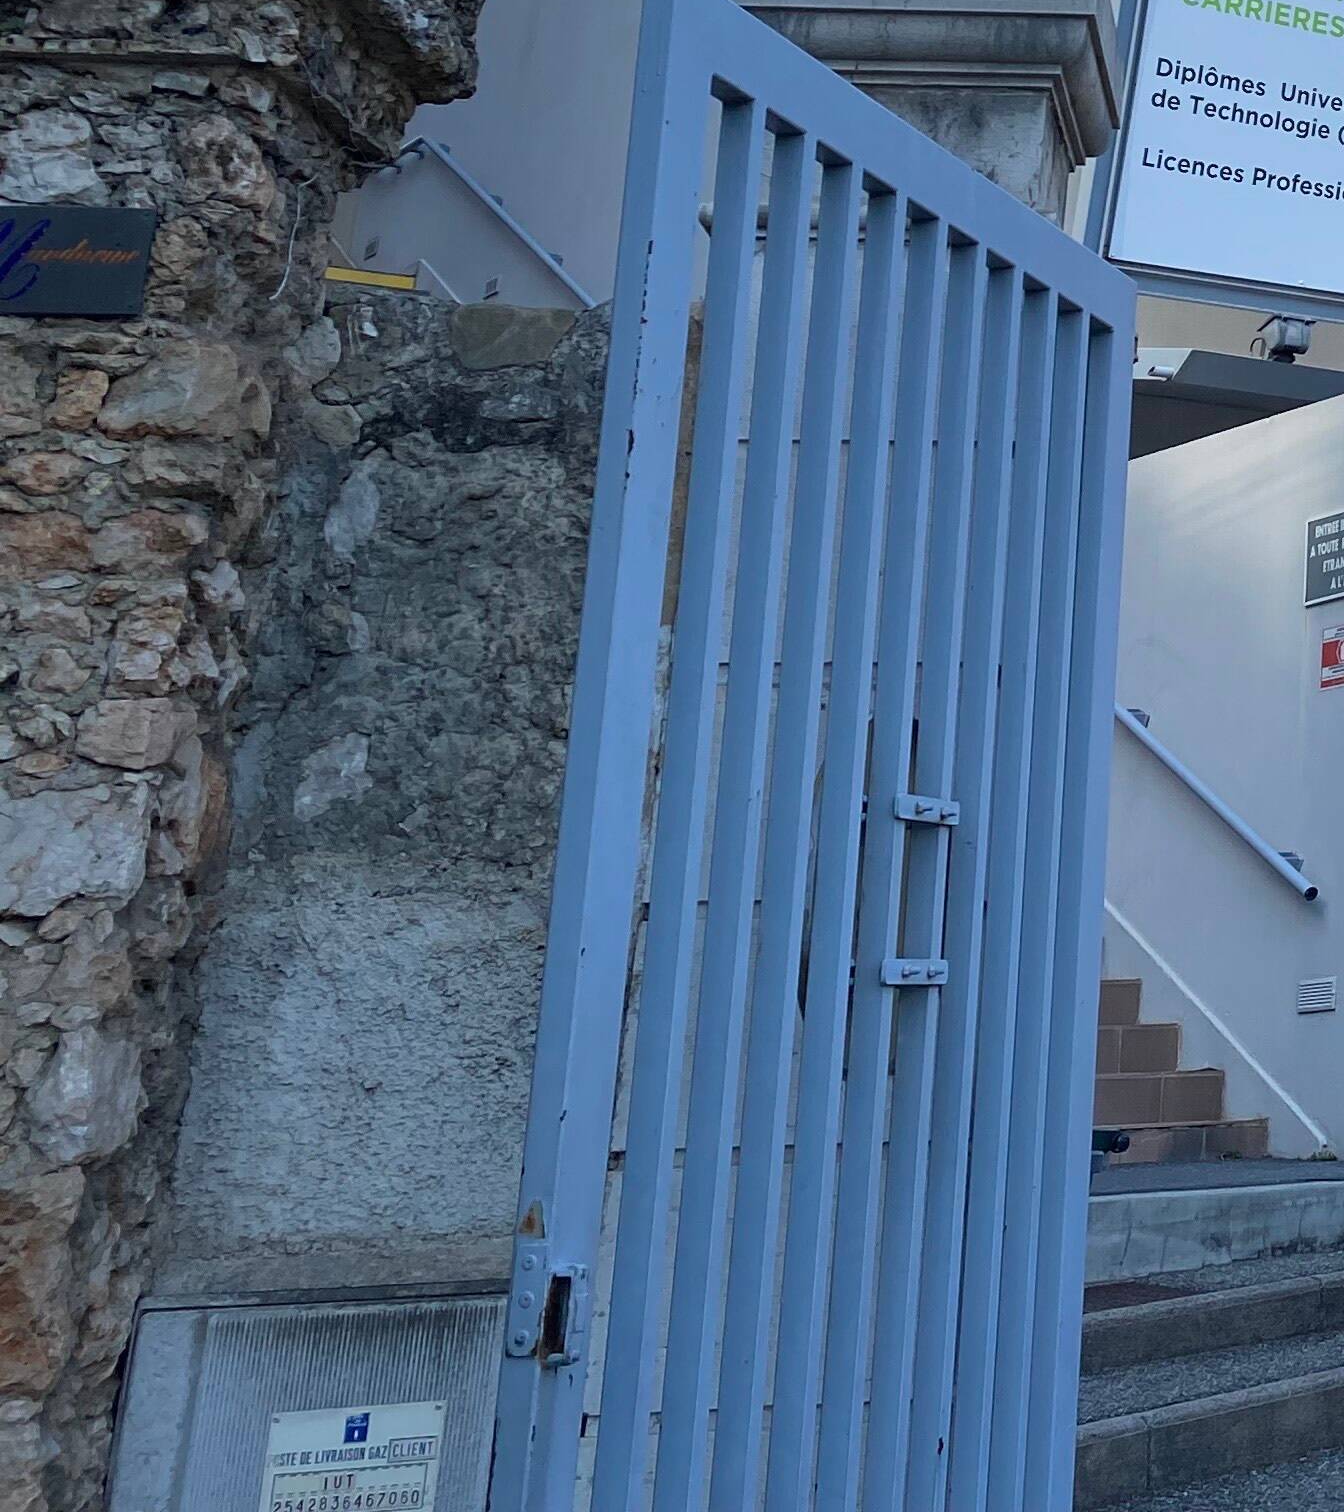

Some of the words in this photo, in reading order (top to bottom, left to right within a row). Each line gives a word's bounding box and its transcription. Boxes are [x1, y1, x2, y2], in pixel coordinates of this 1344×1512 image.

[1155, 57, 1267, 97] Diplômes
[1150, 88, 1182, 112] de
[1190, 94, 1331, 140] Technologie
[1141, 147, 1245, 184] Licences
[1315, 520, 1340, 538] ENTREE
[1309, 544, 1316, 559] A
[1318, 538, 1339, 556] TOUTE
[1330, 576, 1336, 589] A
[300, 1451, 312, 1465] DE
[314, 1447, 366, 1465] LIVRAISON
[368, 1445, 388, 1459] GAZ
[392, 1441, 433, 1458] CLIENT
